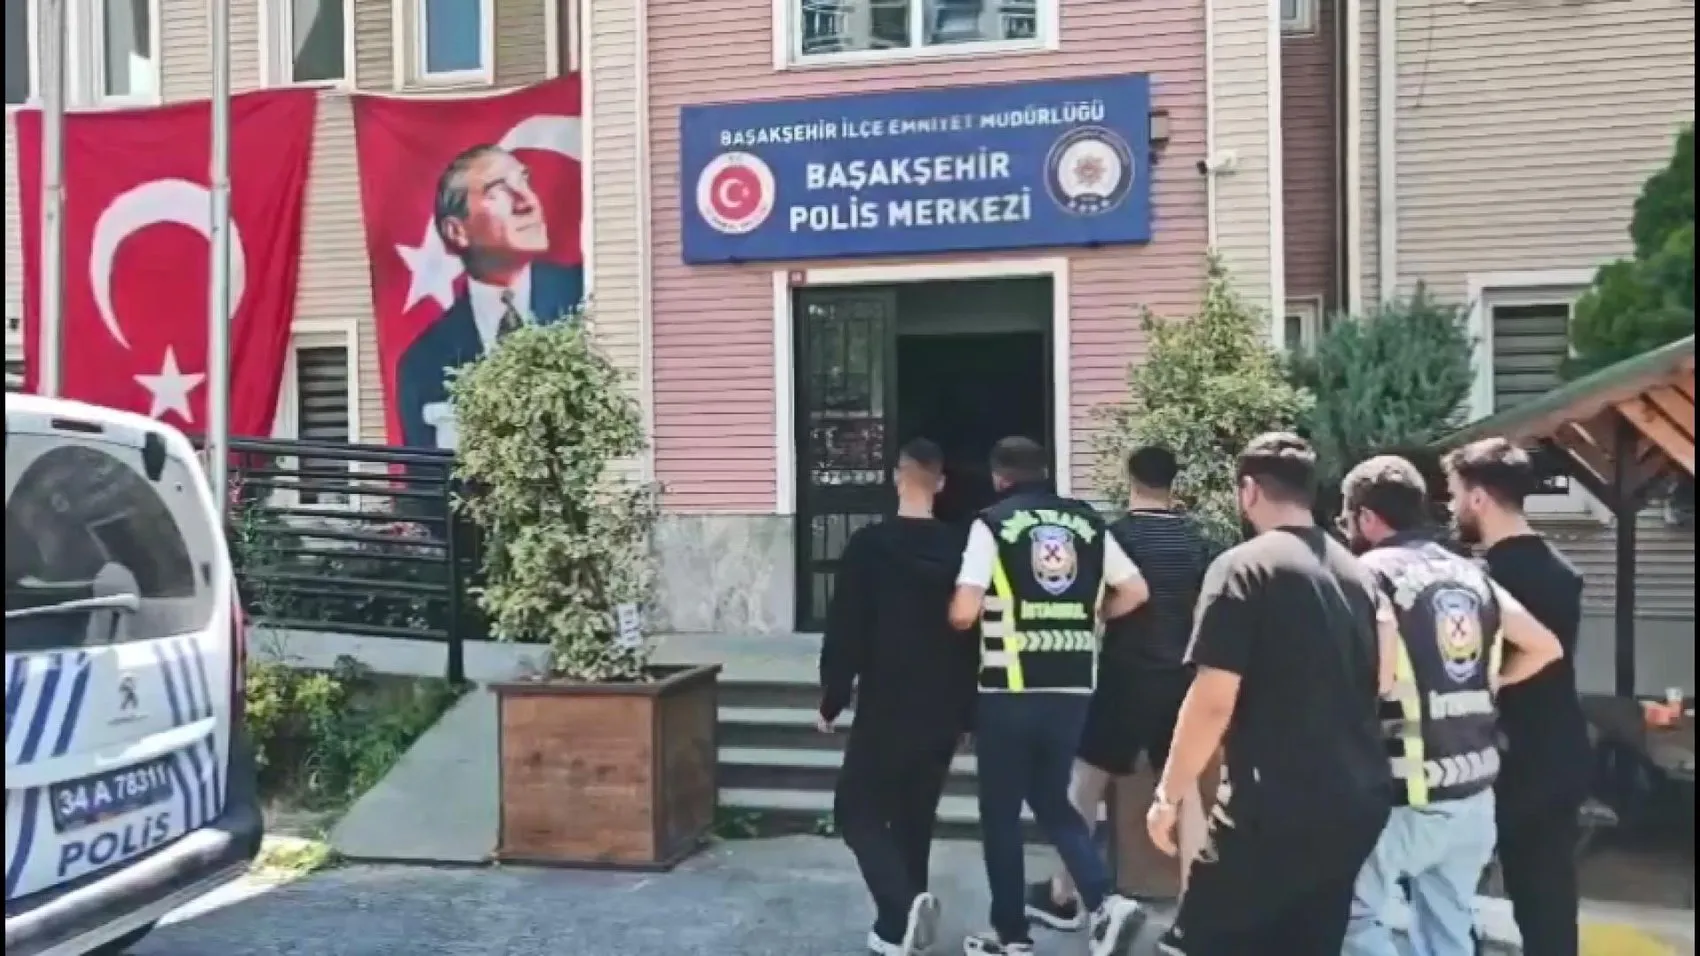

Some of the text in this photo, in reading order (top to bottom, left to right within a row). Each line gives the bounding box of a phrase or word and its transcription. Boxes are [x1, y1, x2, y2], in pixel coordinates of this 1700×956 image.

[719, 118, 837, 147] BAŞAKŞEHİR
[841, 116, 883, 139] İLÇE
[806, 145, 1011, 191] BAŞAKŞEHİR
[789, 195, 880, 233] POLİS
[887, 184, 1032, 228] MERKEZİ
[59, 783, 89, 816] 34
[93, 778, 113, 809] A
